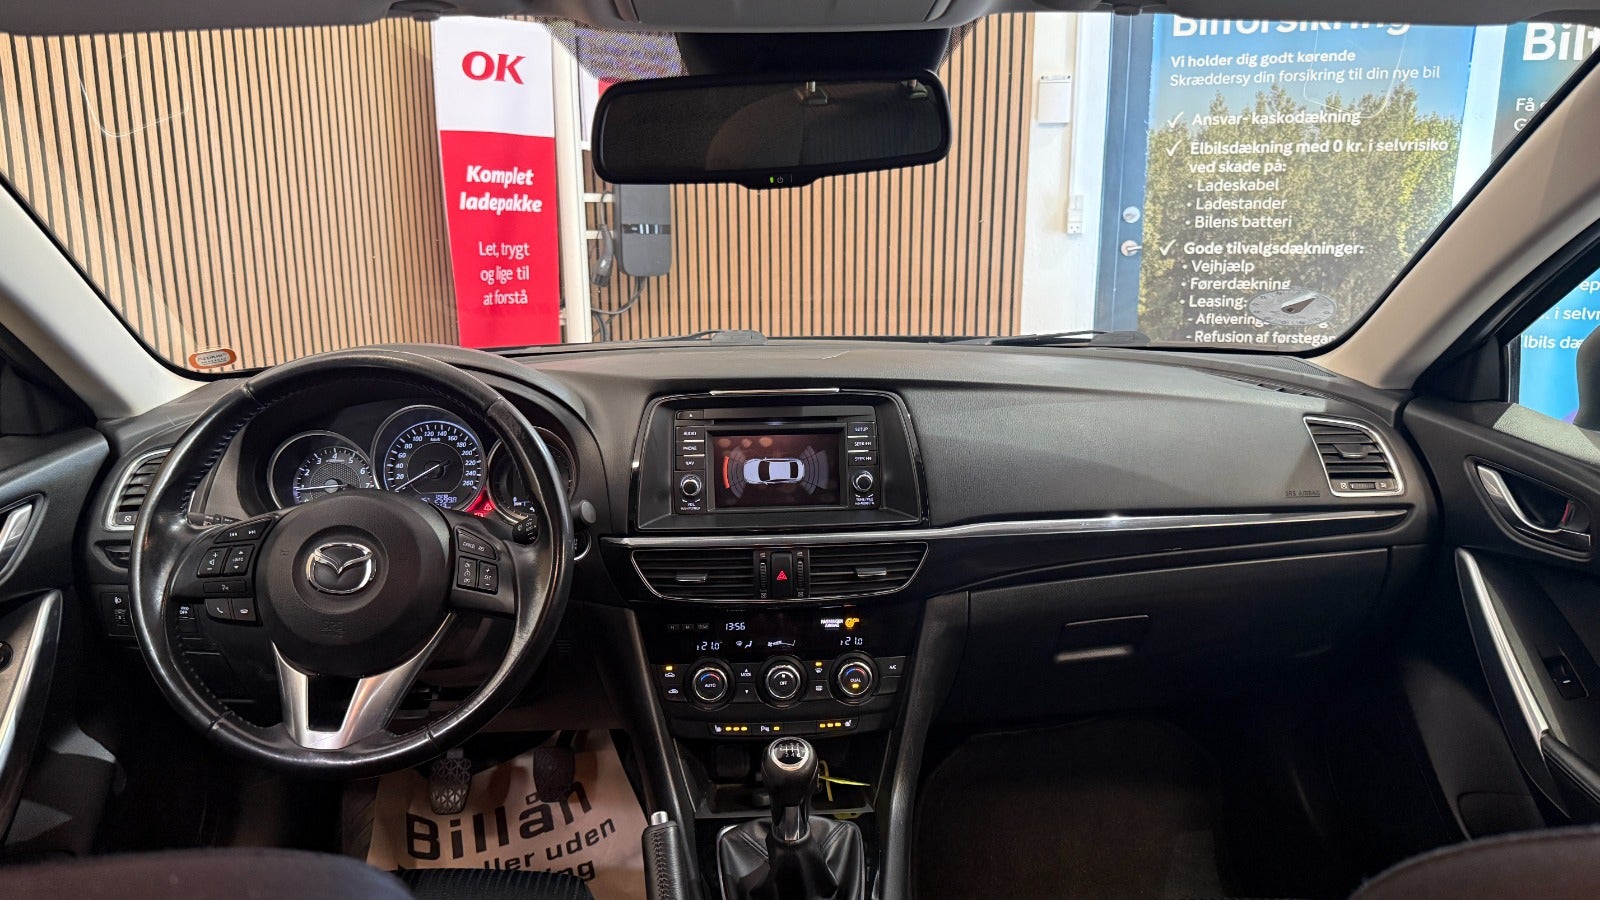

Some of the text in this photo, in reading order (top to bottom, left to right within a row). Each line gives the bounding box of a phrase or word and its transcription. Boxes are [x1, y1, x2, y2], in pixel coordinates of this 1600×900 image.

[1173, 14, 1410, 36] Bilfors
[461, 50, 526, 85] OK
[1170, 50, 1356, 68] Vi holder dig godt kørende
[1170, 66, 1440, 87] Skræddersy din forsikring til din nye bil
[1516, 97, 1535, 112] Få
[1192, 109, 1361, 126] Ansvar- kaskodækning
[1190, 141, 1292, 157] Elbilsdækning
[1296, 140, 1329, 154] med
[1333, 140, 1342, 152] 0
[1346, 140, 1365, 152] kr.
[1376, 138, 1448, 151] selvrisiko
[1189, 159, 1286, 175] ved skade på:
[466, 165, 534, 188] Komplet
[1197, 179, 1279, 192] Ladeskabel
[459, 192, 542, 215] ladepakke
[1195, 198, 1287, 211] Ladestander
[1194, 214, 1292, 228] Bilens batteri
[478, 241, 530, 259] Let, trygt
[1184, 241, 1365, 258] Gode tilvalgsdækninger:
[480, 266, 529, 285] og lige til
[1191, 259, 1255, 276] Vejhjælp
[1190, 278, 1291, 291] Førerdækning
[483, 290, 528, 305] at forstå
[1189, 295, 1248, 311] Leasing:
[1194, 331, 1252, 343] Refusion
[1256, 331, 1269, 343] af
[405, 781, 592, 860] Billån
[545, 818, 616, 860] uden
